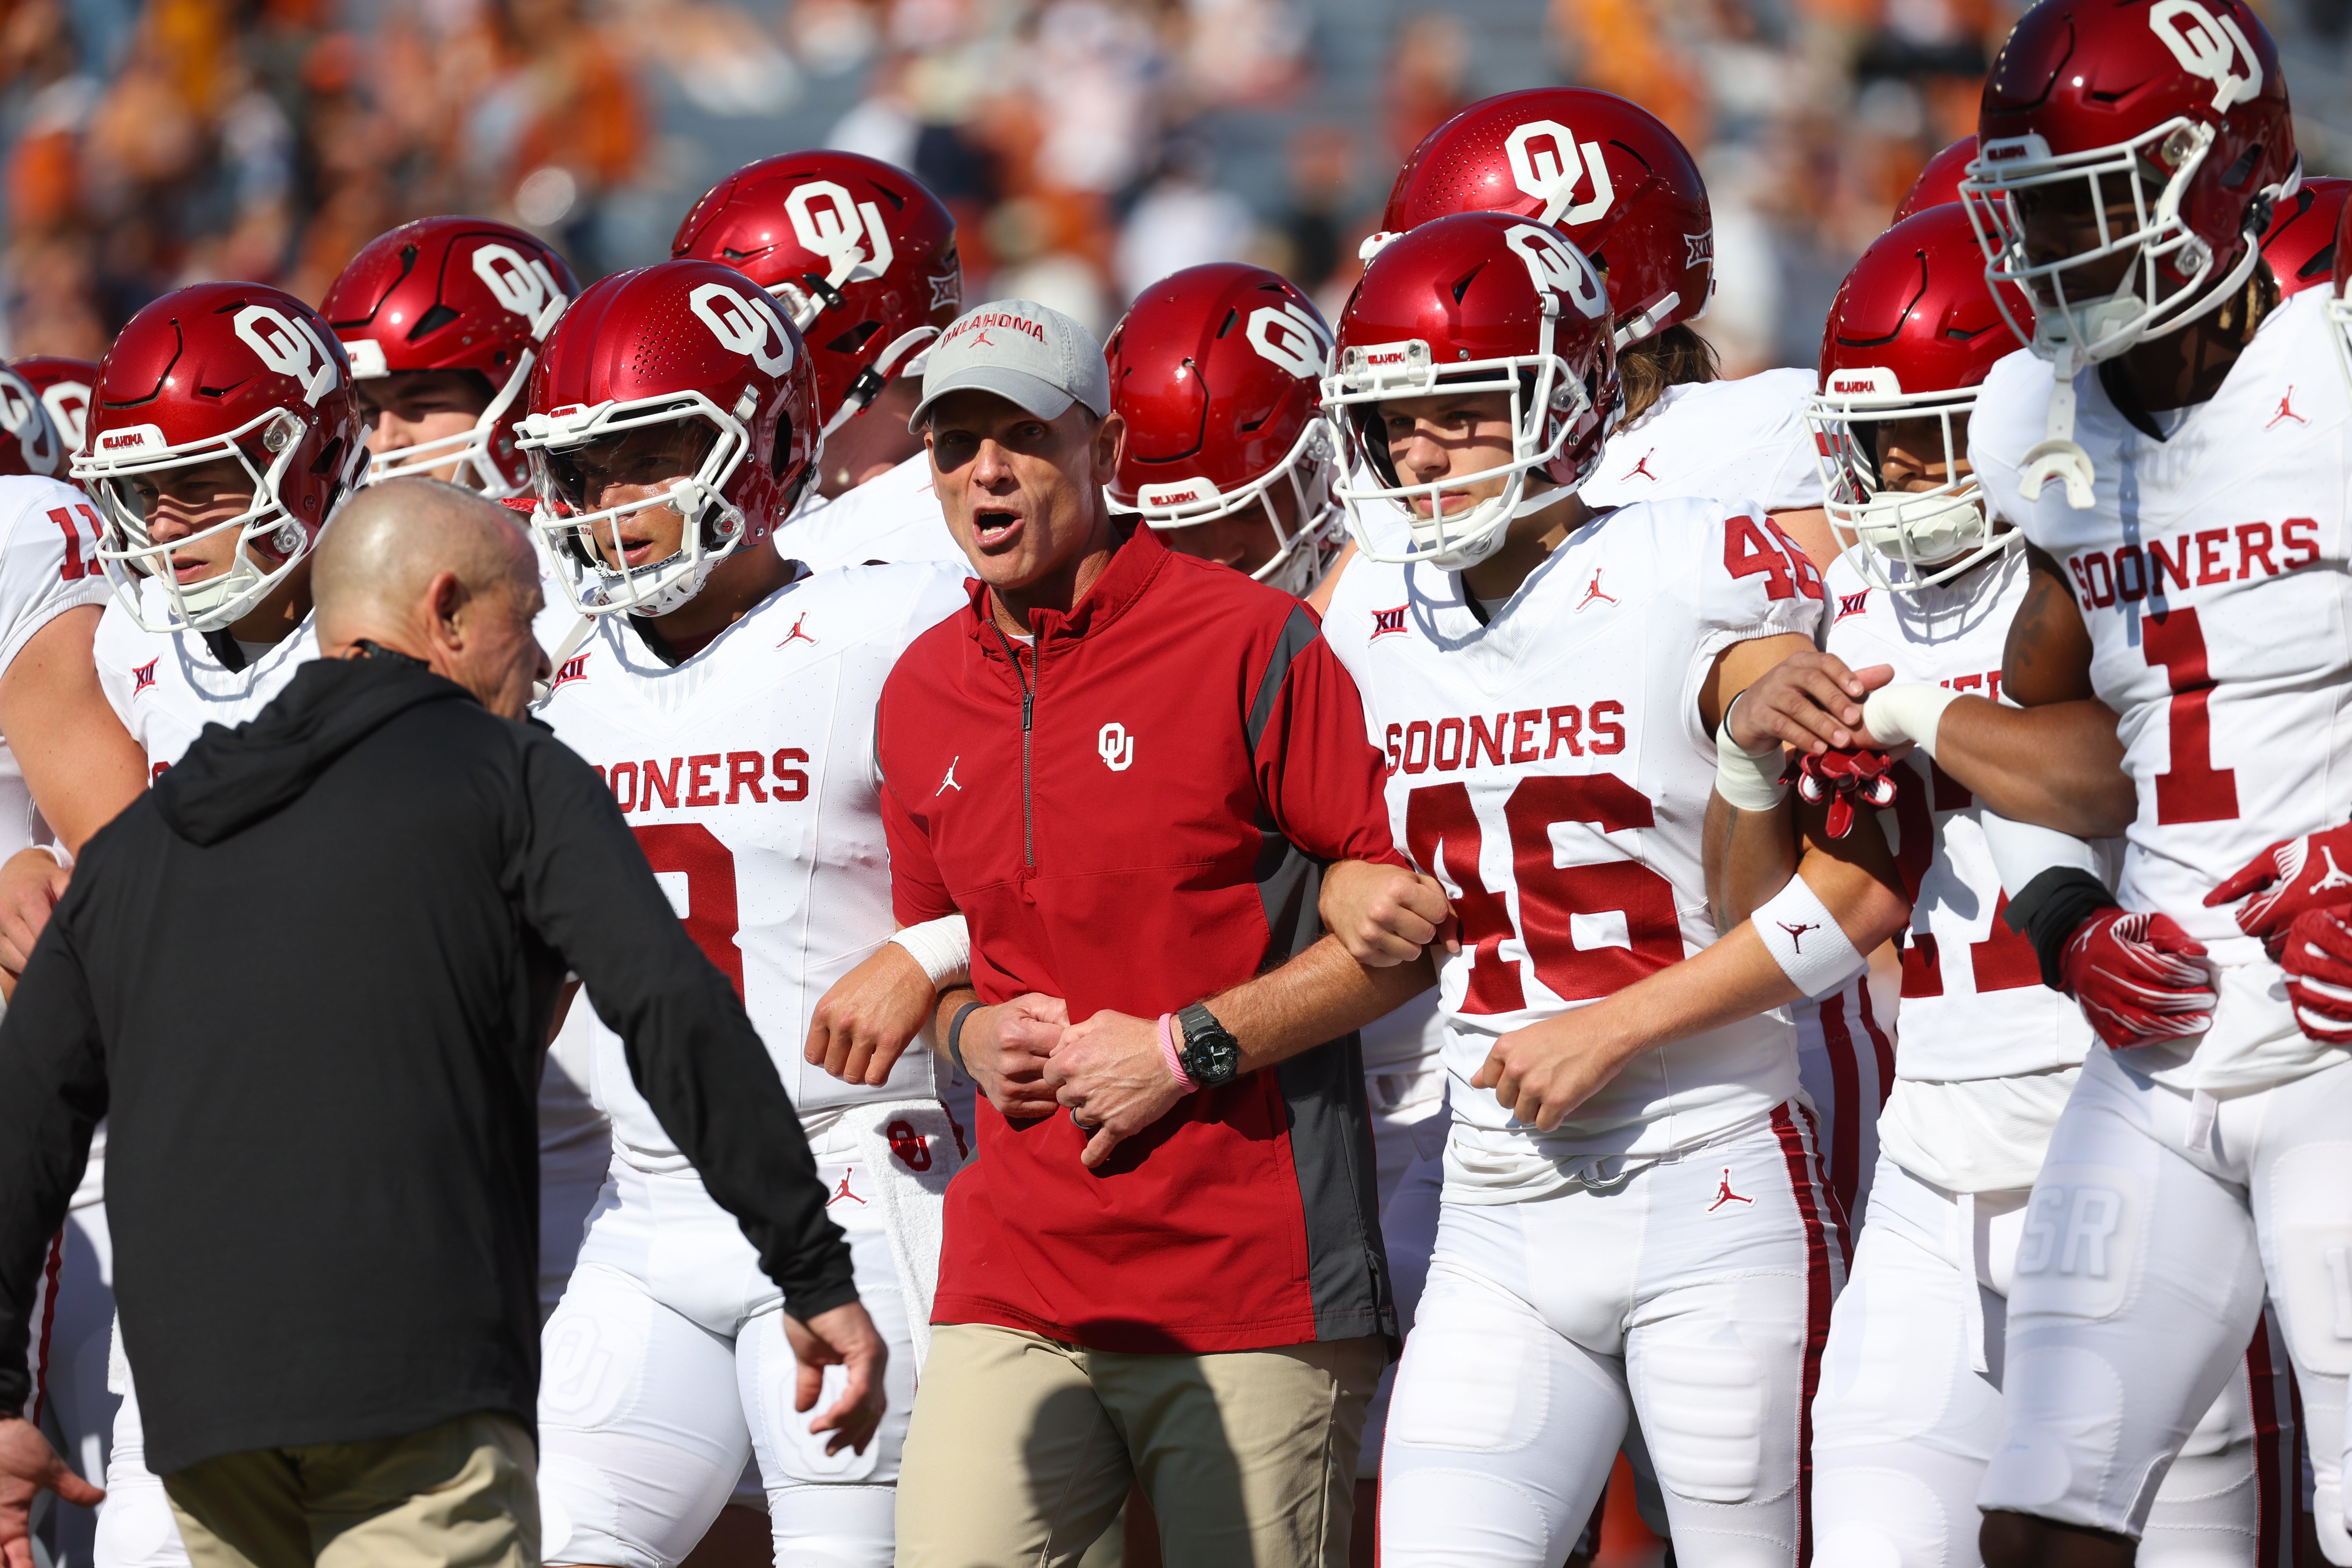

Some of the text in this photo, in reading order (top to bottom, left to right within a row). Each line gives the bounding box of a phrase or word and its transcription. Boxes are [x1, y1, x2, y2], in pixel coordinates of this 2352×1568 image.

[2149, 0, 2263, 104] OU
[1504, 120, 1615, 225] OU
[784, 180, 893, 283] OU
[1504, 223, 1606, 319] OU
[234, 305, 337, 397] OU
[689, 283, 793, 378] OU
[941, 313, 1043, 349] OKLAHOMA
[103, 433, 144, 449] OKLAHOMA
[46, 504, 109, 581] 11
[2070, 518, 2321, 611] SOONERS
[1098, 722, 1134, 771] OU
[1386, 699, 1625, 777] SOONERS
[2141, 606, 2239, 826] 1
[1406, 773, 1685, 1014] 46
[886, 1120, 932, 1172] OU
[2018, 1187, 2122, 1277] SR
